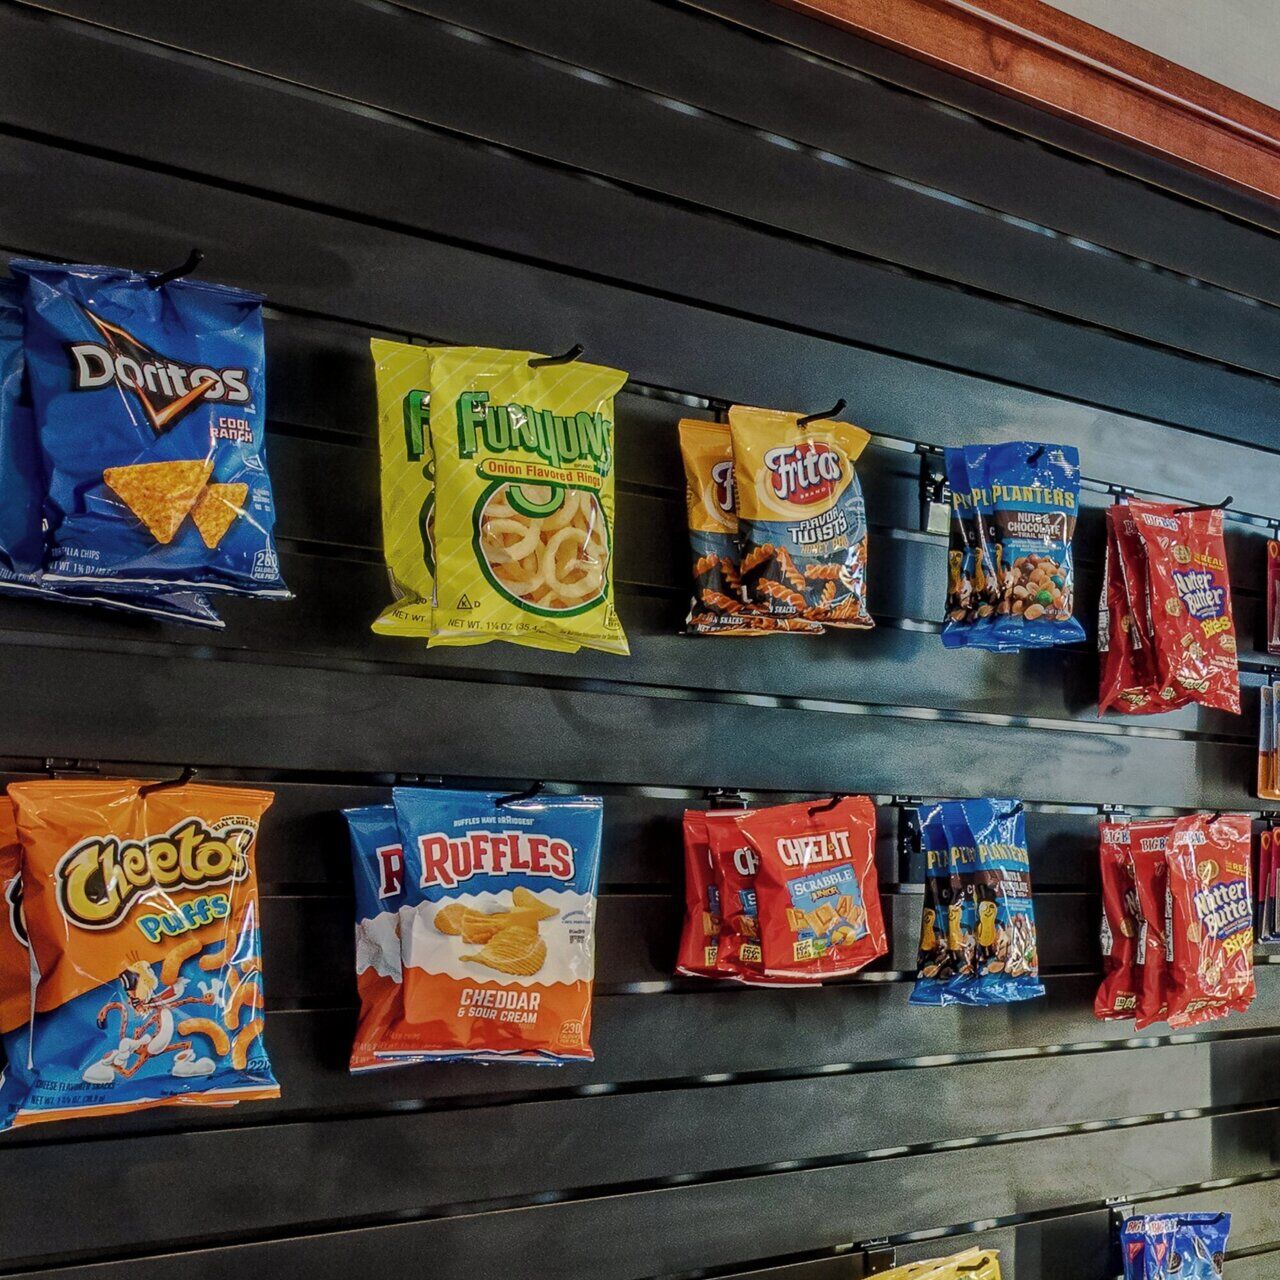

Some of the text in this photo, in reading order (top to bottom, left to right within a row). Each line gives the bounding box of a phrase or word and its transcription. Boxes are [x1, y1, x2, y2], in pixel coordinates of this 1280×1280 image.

[72, 344, 251, 403] Doritos
[210, 428, 253, 443] RANCH
[219, 417, 251, 431] COOL
[489, 461, 601, 487] Onion Flavored Rings
[764, 446, 843, 500] Fritos
[800, 487, 826, 499] BRAND
[992, 485, 1075, 510] PLANTERS
[787, 514, 849, 545] TWISTS
[799, 507, 839, 533] FLAVOR
[1007, 522, 1061, 536] CHOCOLATE
[1017, 512, 1052, 525] NUTS &
[1018, 532, 1038, 540] TRAIL
[80, 549, 101, 560] CHIPS
[1201, 555, 1225, 567] REAL
[1173, 570, 1214, 597] Nutter
[774, 605, 797, 614] SNACKS
[1184, 587, 1224, 616] Butter
[448, 618, 466, 629] NET
[501, 621, 514, 631] OZ
[719, 615, 744, 624] SNACKS
[1200, 616, 1231, 639] Bites
[420, 832, 575, 887] RUFFLES
[61, 823, 254, 928] Cheetos
[794, 869, 853, 896] SCRABBLE
[1194, 881, 1245, 917] Nutter
[137, 895, 231, 943] Puffs
[1222, 928, 1252, 956] Bite
[460, 988, 541, 1010] CHEDDAR
[457, 1007, 538, 1024] & SOUR CREAM
[561, 1022, 581, 1034] 230
